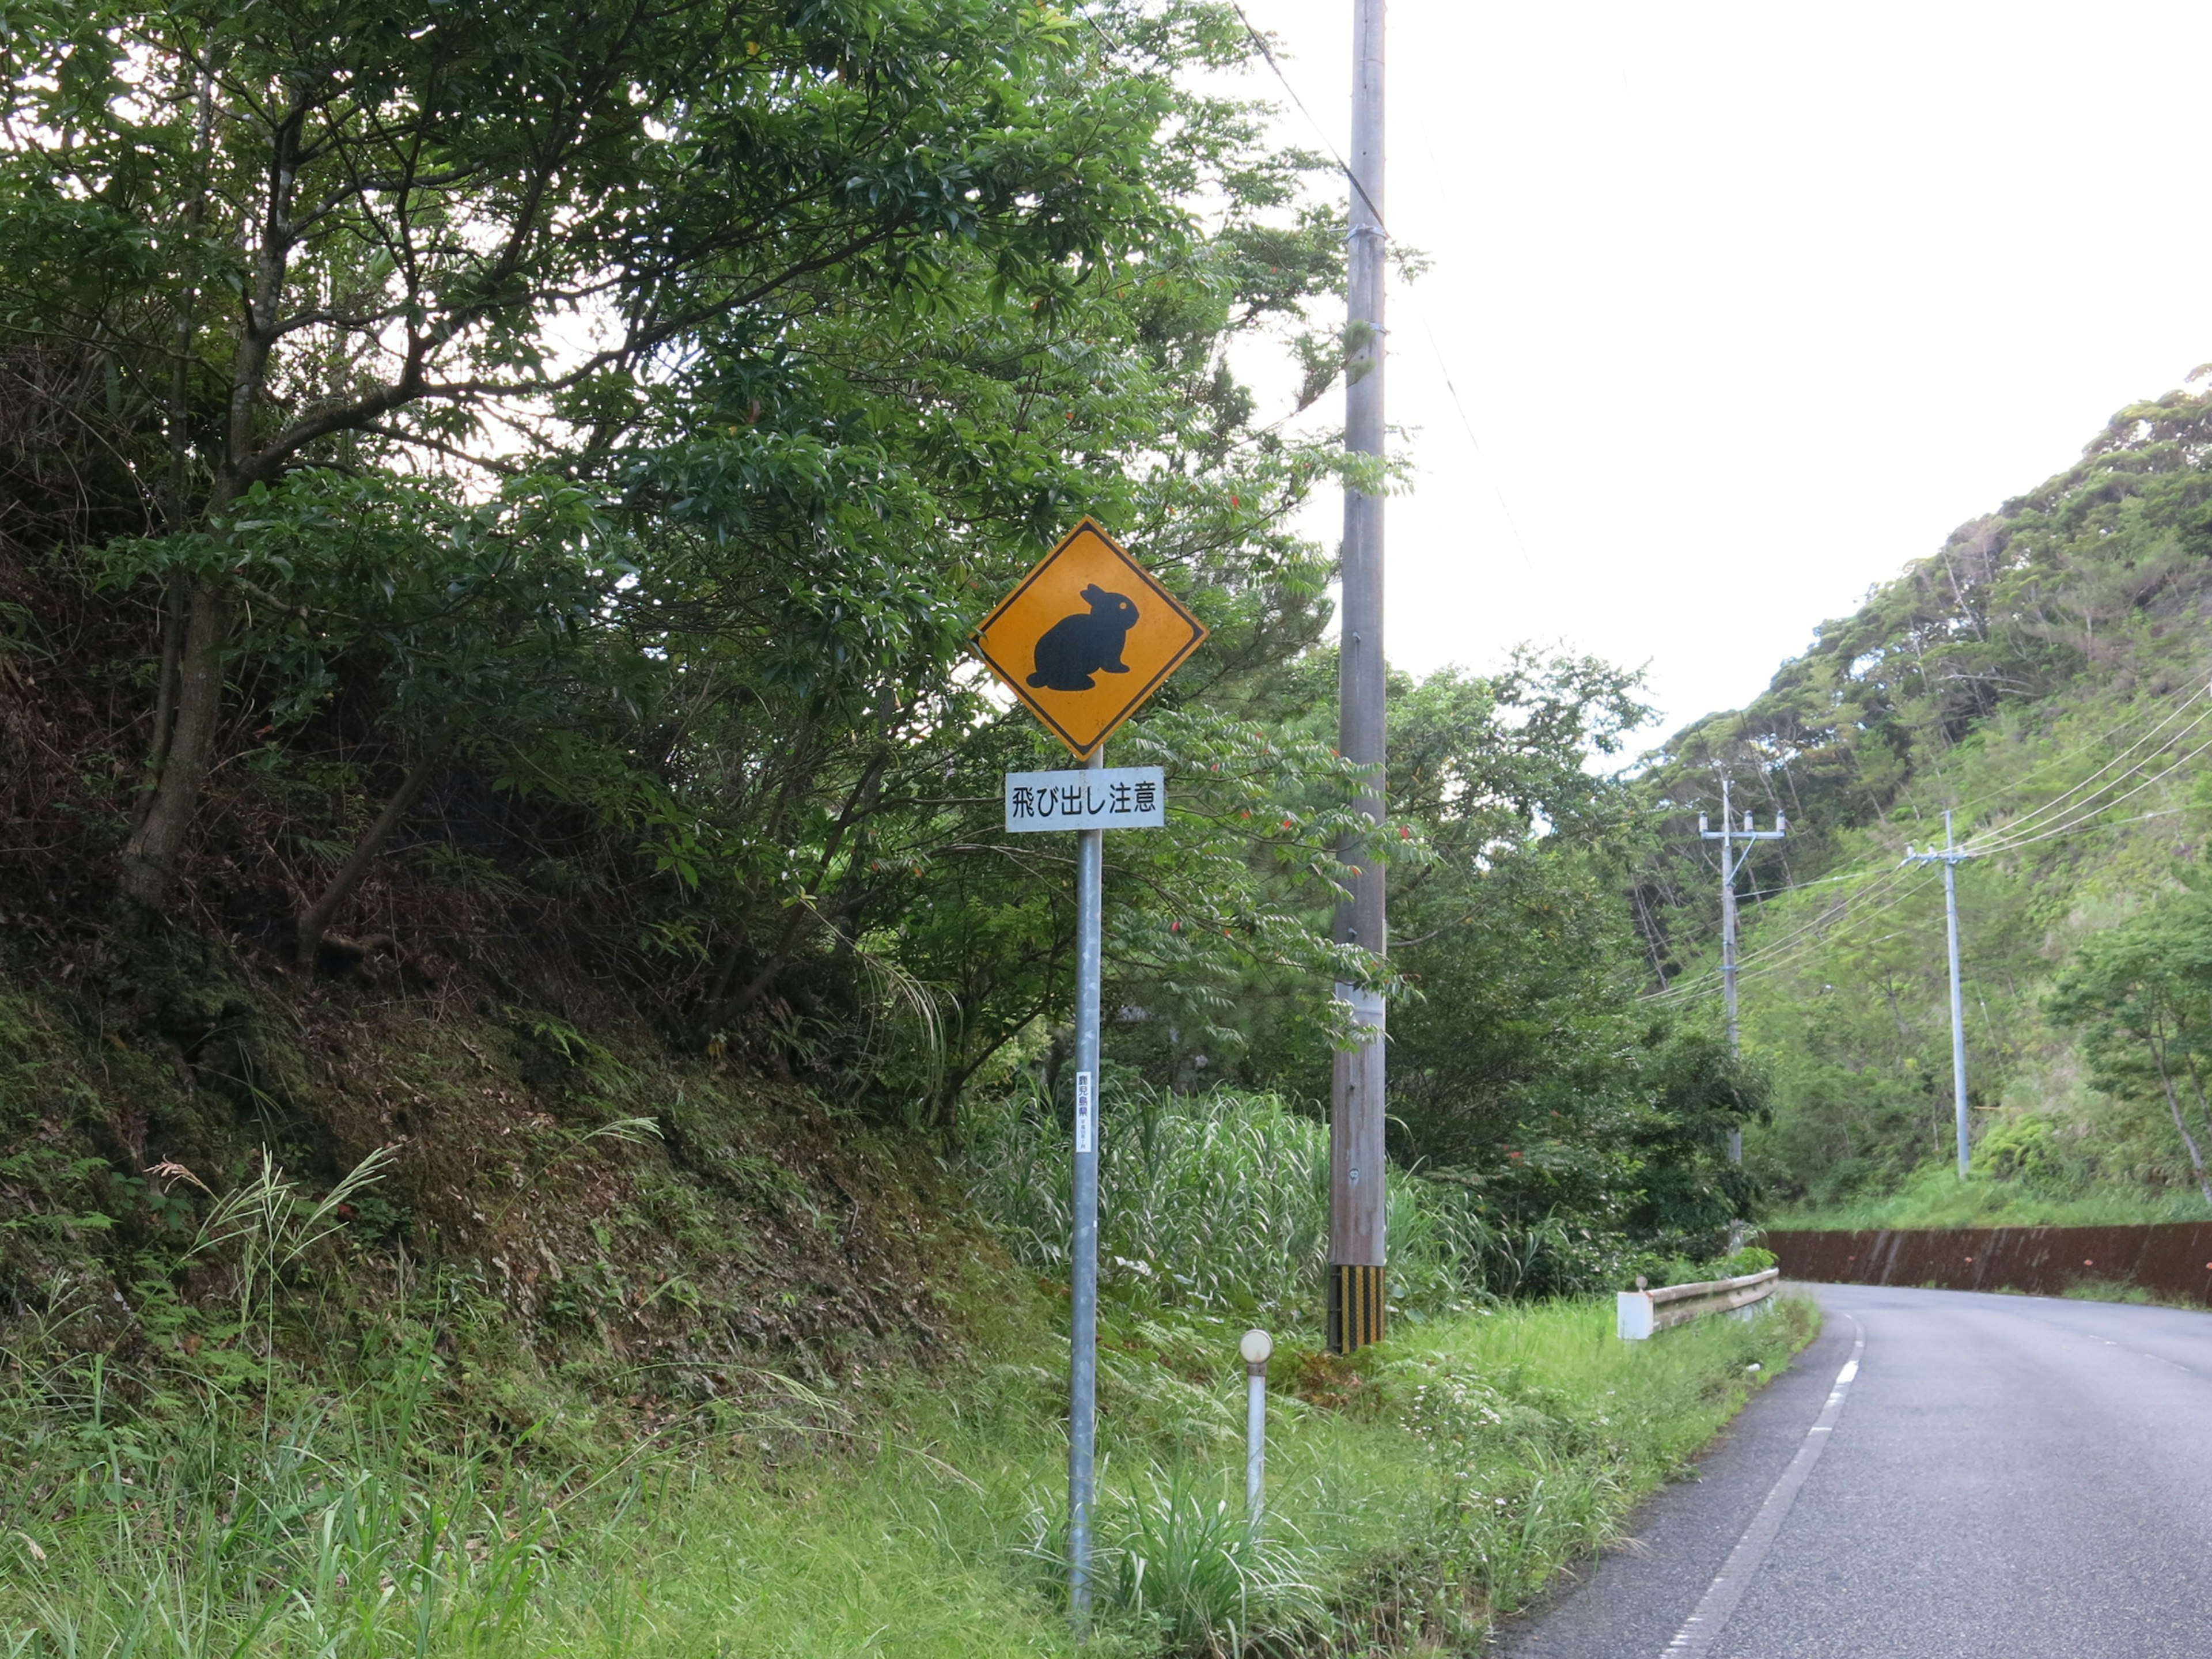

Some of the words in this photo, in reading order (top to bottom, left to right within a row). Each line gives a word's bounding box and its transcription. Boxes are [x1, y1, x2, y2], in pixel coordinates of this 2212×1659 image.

[1013, 781, 1156, 818] 飛び出し注意
[1078, 1075, 1088, 1117] 鹿児島県
